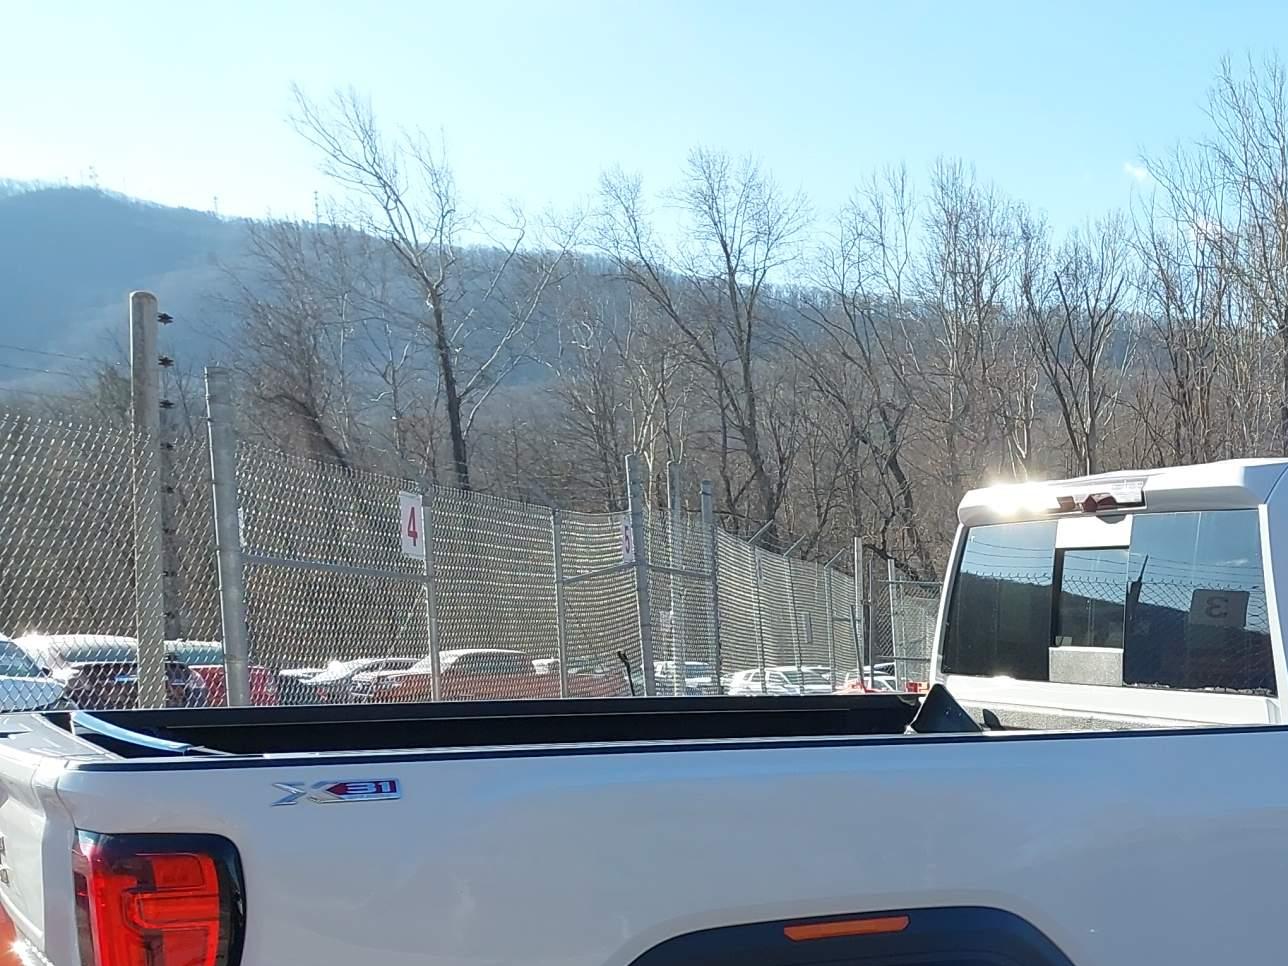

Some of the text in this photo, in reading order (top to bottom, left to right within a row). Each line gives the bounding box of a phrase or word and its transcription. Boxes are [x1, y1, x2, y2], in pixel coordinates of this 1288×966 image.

[407, 506, 418, 547] 4
[624, 525, 631, 554] 5
[271, 779, 400, 806] X31
